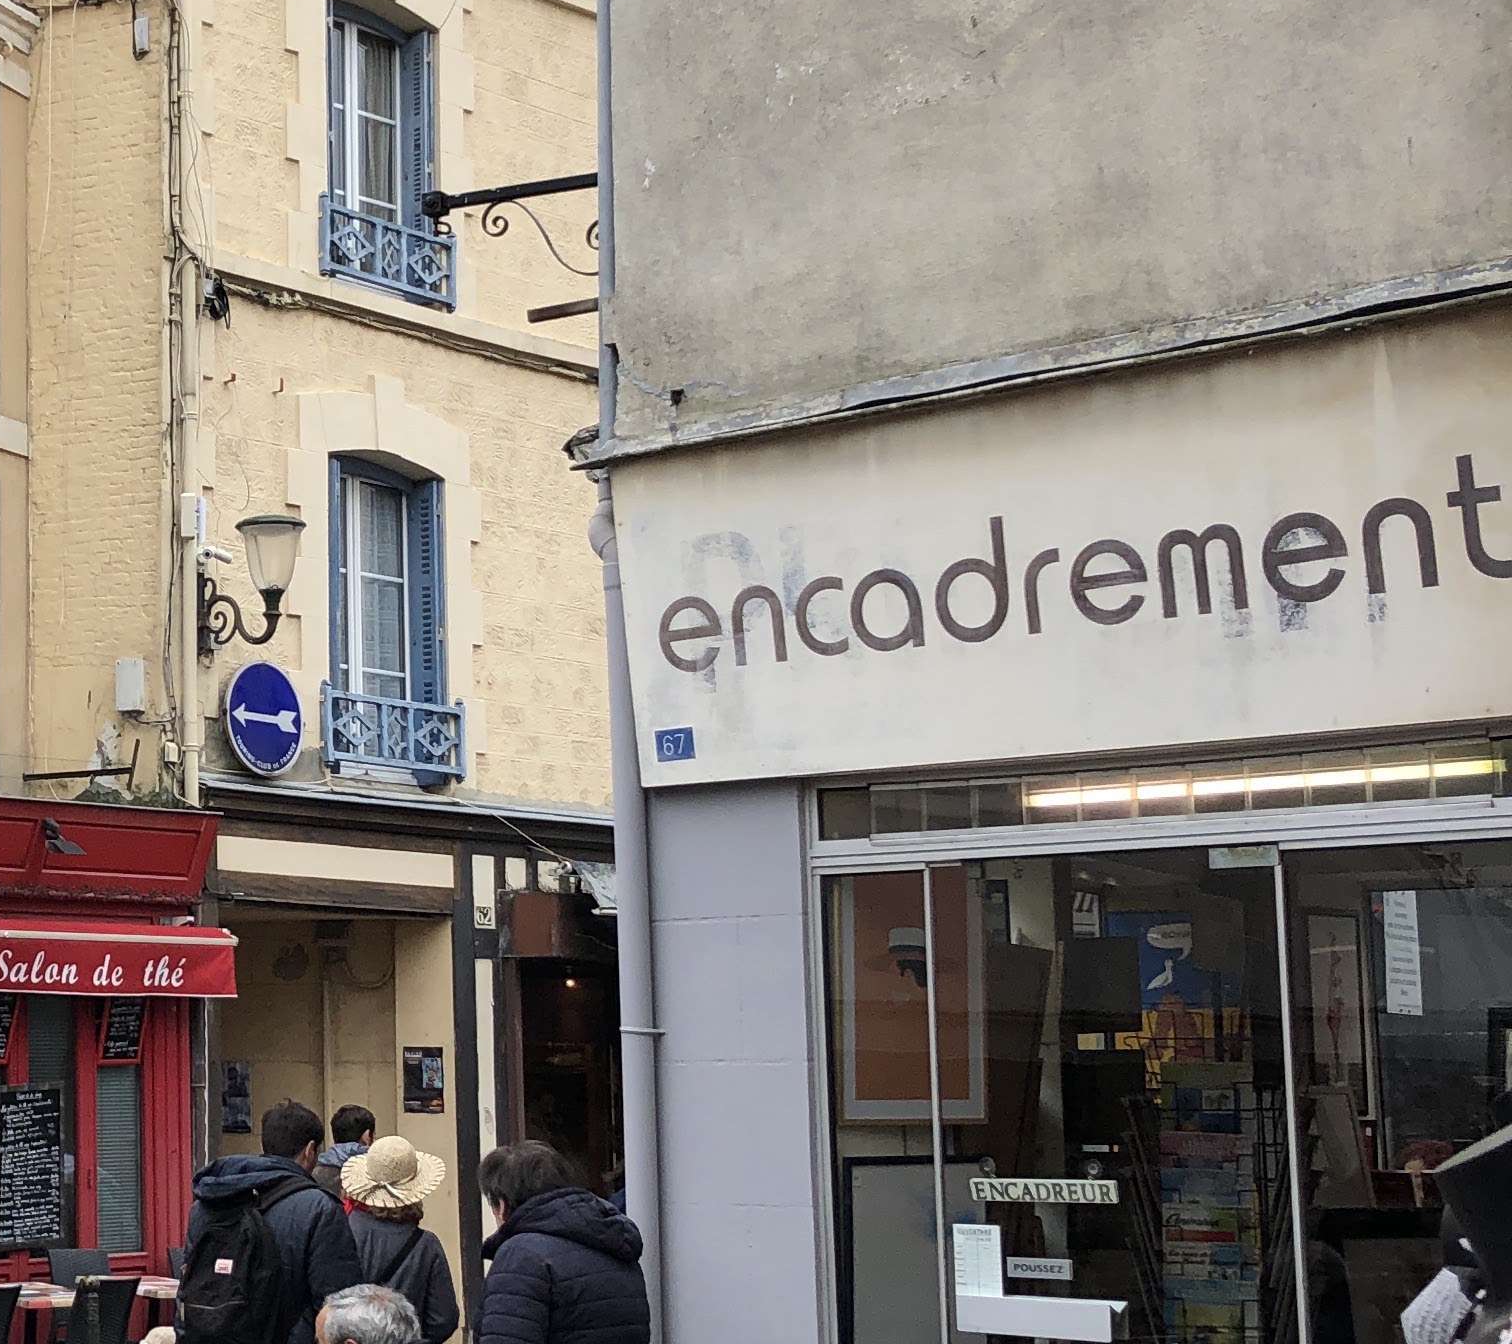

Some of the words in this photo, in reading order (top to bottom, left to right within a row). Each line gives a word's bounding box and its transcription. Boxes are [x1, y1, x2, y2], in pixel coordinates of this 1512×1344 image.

[659, 454, 1512, 674] encadrement
[662, 733, 685, 756] 67
[476, 906, 492, 925] 62
[92, 953, 124, 987] de
[143, 954, 187, 988] thé
[972, 1181, 1114, 1203] ENCADREUR
[1013, 1263, 1063, 1274] POUSSEZ
